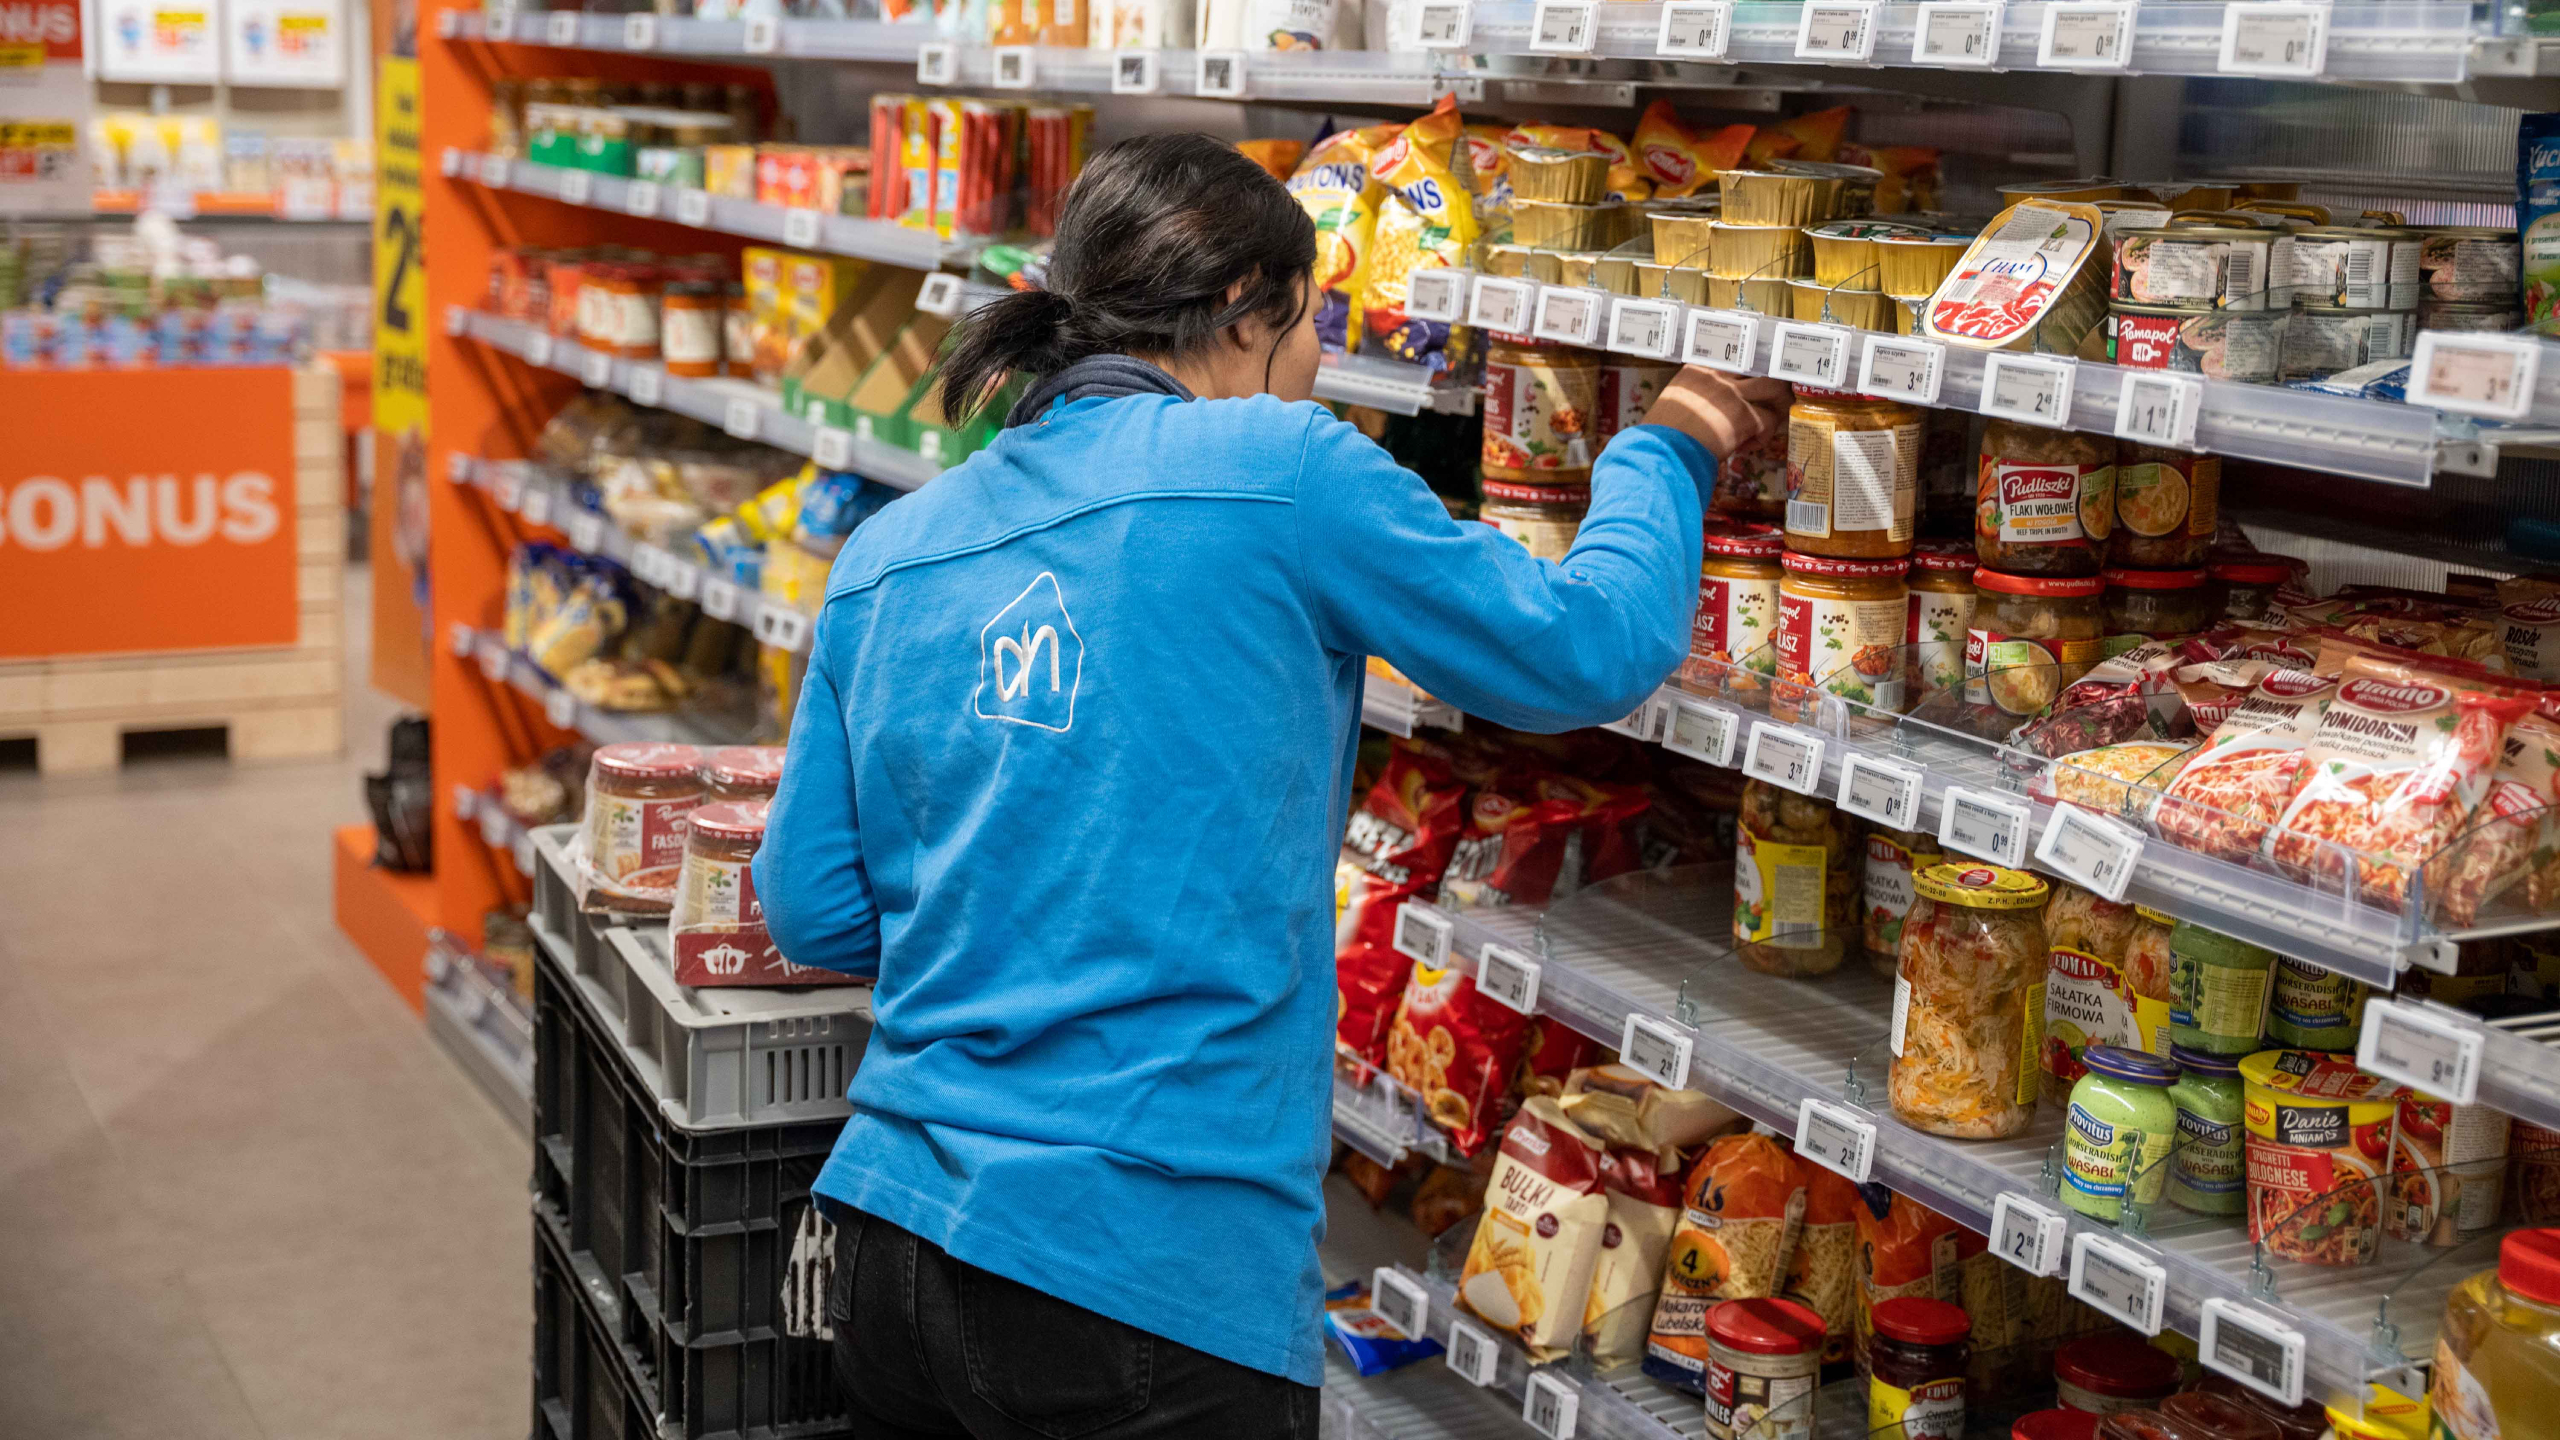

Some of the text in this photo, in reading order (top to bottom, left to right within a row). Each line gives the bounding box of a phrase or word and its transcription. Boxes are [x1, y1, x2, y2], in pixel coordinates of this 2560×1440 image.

[0, 3, 77, 43] NUS
[1842, 30, 1859, 49] 0.99
[385, 207, 419, 332] 2
[2119, 319, 2176, 345] Pamapol
[1816, 357, 1831, 376] 1.49
[1907, 371, 1925, 391] 3.49
[2033, 392, 2054, 413] 2.49
[2146, 405, 2167, 433] 1.19
[2004, 475, 2071, 500] Pudliszki
[0, 472, 281, 552] ONUS
[2010, 502, 2074, 516] FLAKI WOŁOWE
[2016, 526, 2068, 536] BEEF TRIPE IN BROTH
[1693, 614, 1715, 632] LASZ
[1777, 630, 1798, 653] LASZ
[2505, 626, 2542, 648] ROSÓŁ
[2351, 679, 2436, 705] amino
[2320, 710, 2418, 745] POMIDOROWA
[1788, 762, 1803, 781] 3.79
[1885, 797, 1901, 818] 0.99
[1992, 833, 2009, 854] 0.99
[2092, 860, 2113, 881] 0.99
[2055, 954, 2097, 977] EDMAL
[2281, 954, 2326, 976] rovitus
[2050, 983, 2103, 1008] SAŁATKA
[2281, 993, 2332, 1010] WASABI
[2047, 998, 2105, 1025] FIRMOWA
[2070, 1106, 2111, 1141] Provitus
[2282, 1109, 2342, 1130] Danie
[2290, 1133, 2324, 1144] MNIAM
[1840, 1147, 1855, 1167] 2.39
[2068, 1136, 2123, 1164] HORSERADISH
[2252, 1149, 2291, 1167] SPAGHETTI
[2068, 1156, 2114, 1179] WASABI
[2181, 1158, 2235, 1176] WASABI
[2249, 1161, 2309, 1187] BOLOGNESE
[2014, 1232, 2035, 1259] 2.99
[1682, 1249, 1698, 1274] 4
[2127, 1294, 2144, 1317] 1.79
